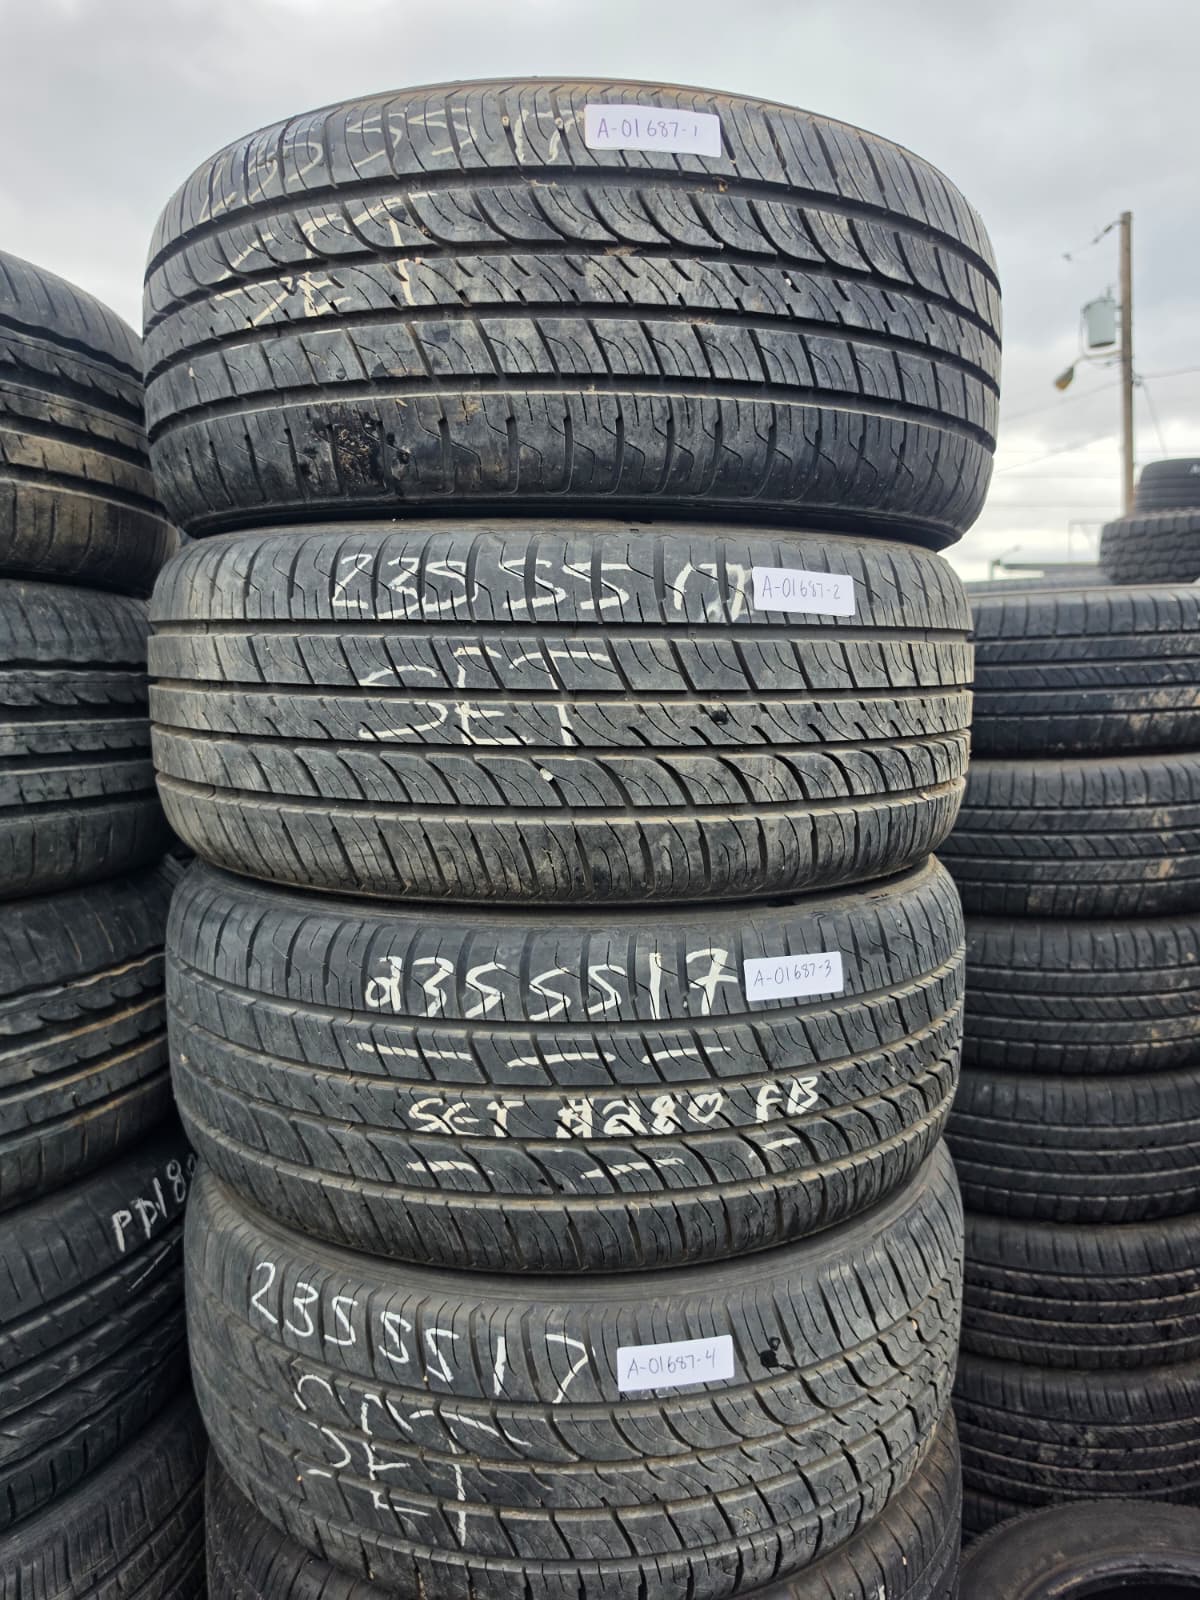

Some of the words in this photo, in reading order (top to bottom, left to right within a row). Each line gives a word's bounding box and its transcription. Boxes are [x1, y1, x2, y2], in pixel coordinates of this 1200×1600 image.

[213, 192, 438, 328] SET
[762, 576, 841, 600] A-01687-2
[358, 646, 611, 746] SET
[753, 959, 832, 987] A-01687-3
[408, 1097, 524, 1138] SET
[755, 1076, 819, 1123] FB
[627, 1348, 716, 1379] A-01687-4
[294, 1373, 533, 1548] SET
